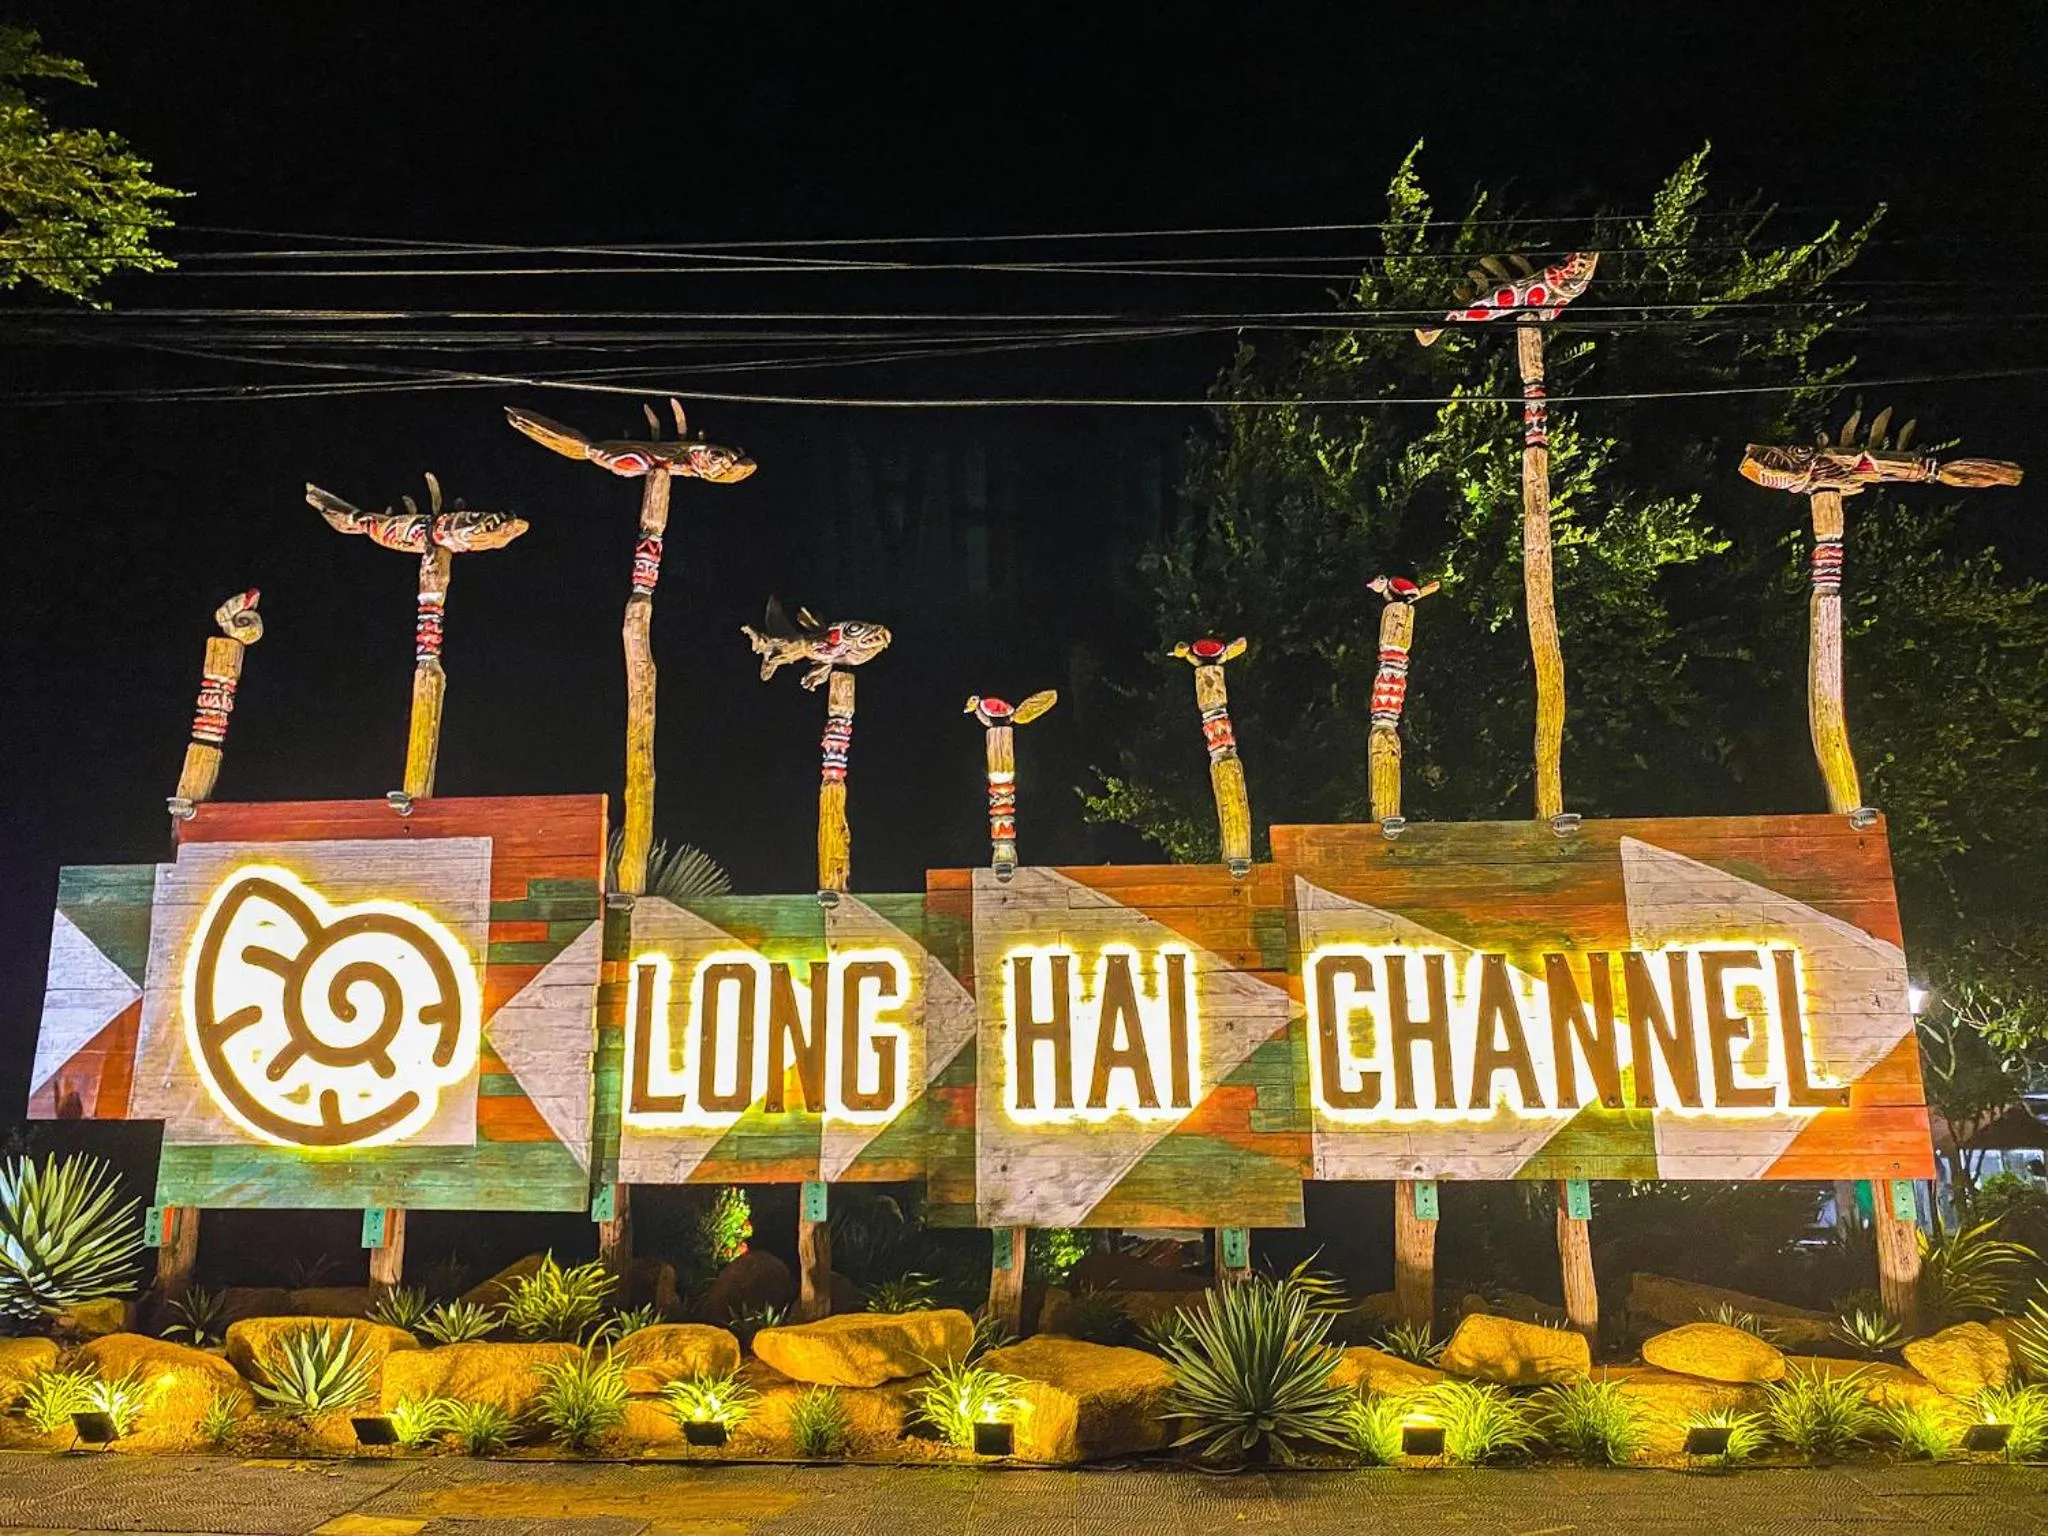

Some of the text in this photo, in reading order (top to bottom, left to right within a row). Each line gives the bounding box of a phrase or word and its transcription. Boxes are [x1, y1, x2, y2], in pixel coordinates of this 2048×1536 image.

[629, 949, 1851, 1114] LONG HAI CHANNEL
